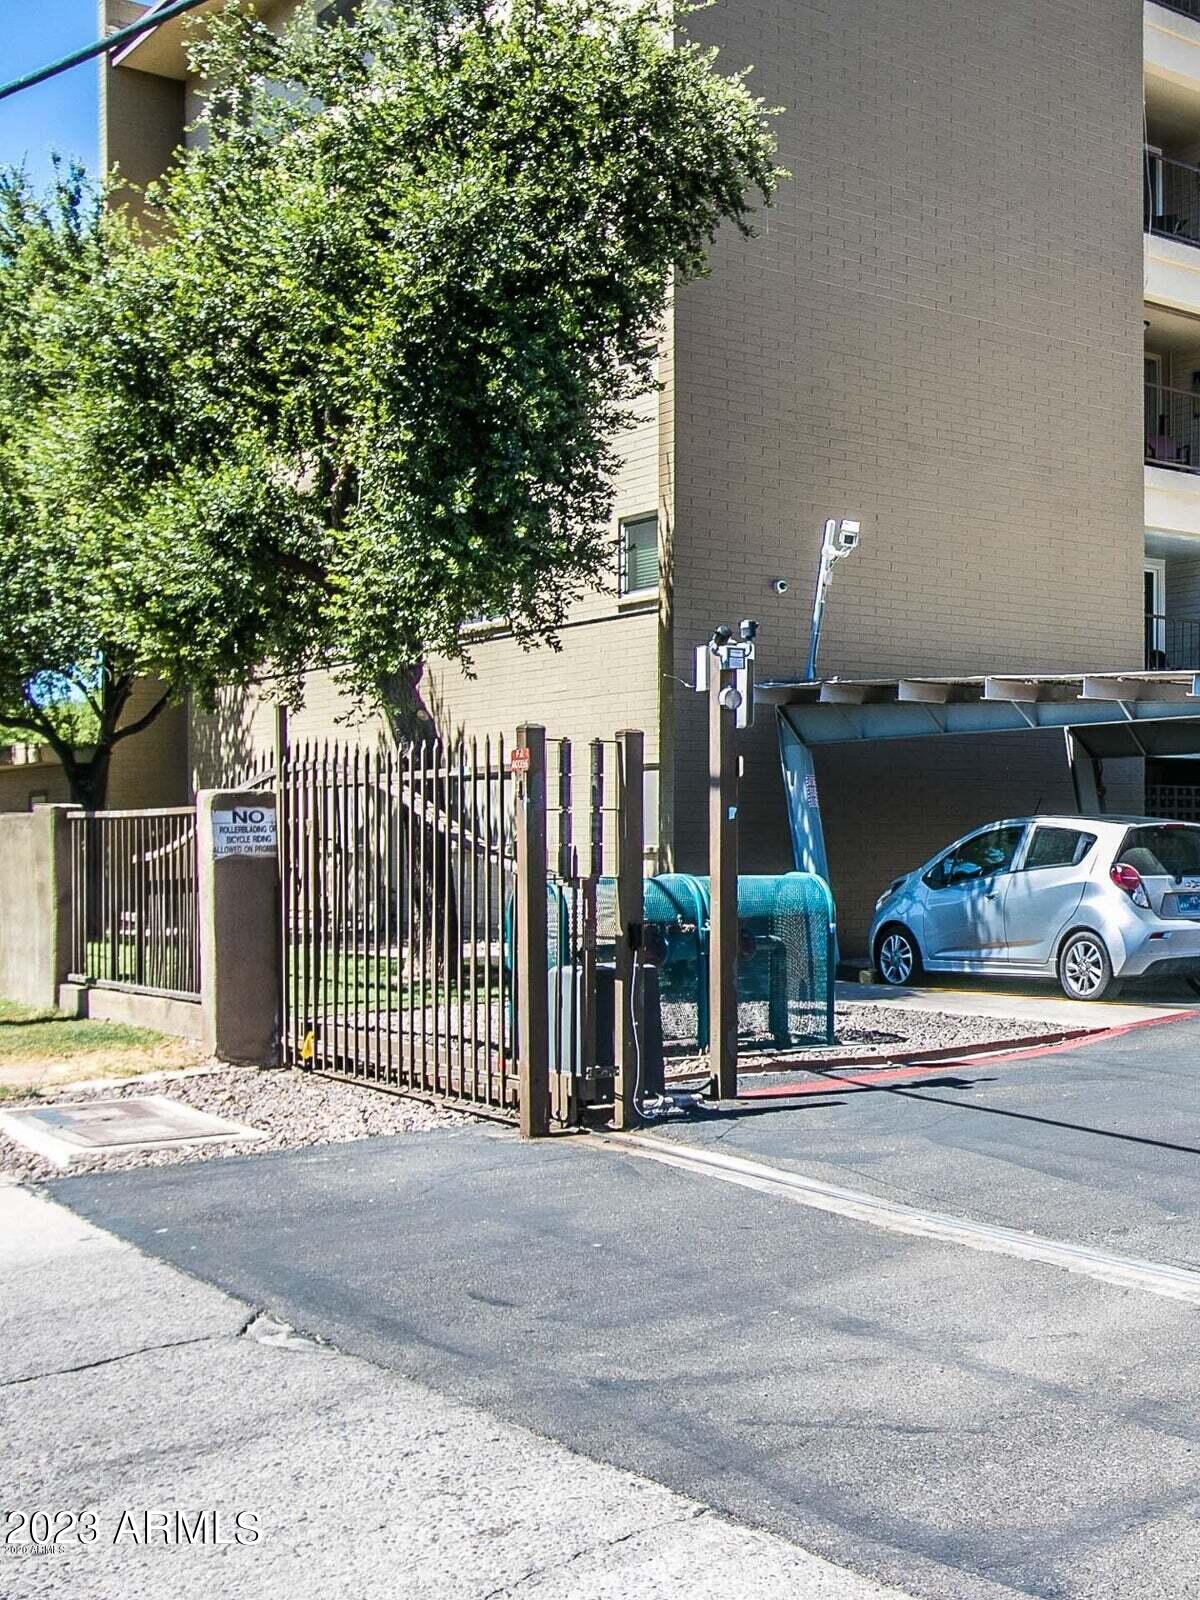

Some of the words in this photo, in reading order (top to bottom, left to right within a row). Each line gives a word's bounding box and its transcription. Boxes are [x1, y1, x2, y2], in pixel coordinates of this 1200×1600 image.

[511, 759, 529, 769] ACCESS
[232, 810, 265, 824] NO
[219, 825, 268, 834] ROLLERBLADING
[226, 835, 252, 844] BICYCLE
[252, 835, 272, 843] RIDING
[243, 845, 253, 853] ON
